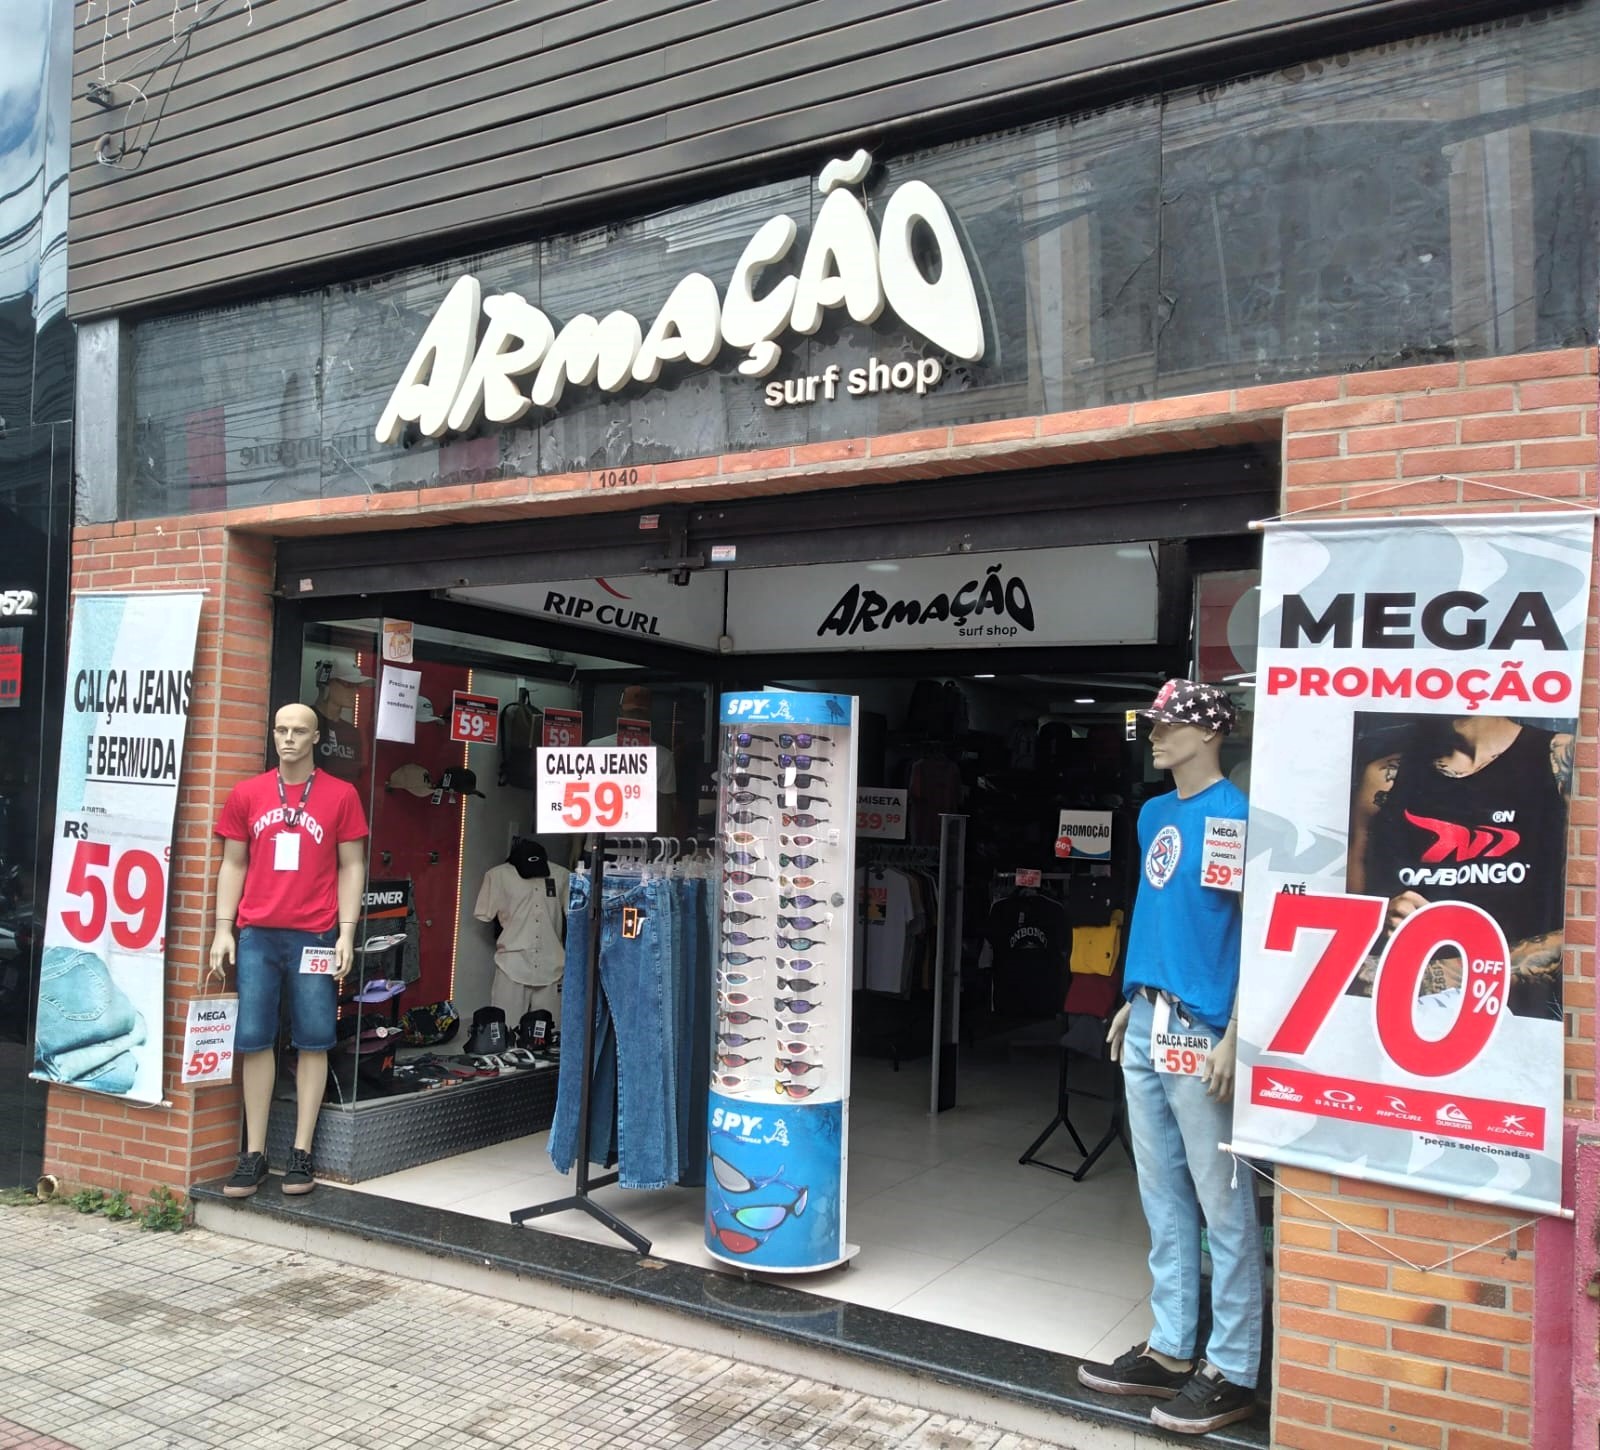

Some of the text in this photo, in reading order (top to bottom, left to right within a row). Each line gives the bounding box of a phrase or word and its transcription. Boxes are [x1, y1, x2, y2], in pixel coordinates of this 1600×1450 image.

[375, 148, 985, 444] ARMAÇÃO
[765, 356, 943, 408] surf shop
[599, 469, 639, 488] 1040
[0, 590, 36, 616] 52
[817, 563, 1036, 637] ARMAÇÃO
[544, 591, 662, 637] RIP CURL
[1279, 590, 1569, 651] MEGA
[958, 623, 1019, 638] surf shop
[1267, 660, 1573, 711] PROMOÇÃO
[74, 669, 129, 725] CALÇA
[133, 669, 193, 716] JEANS
[727, 699, 770, 715] SPY
[459, 711, 484, 737] 59
[549, 727, 570, 747] 59
[97, 736, 177, 780] BERMUDA
[546, 753, 648, 780] CALÇA JEANS
[624, 785, 641, 799] 99
[856, 795, 901, 807] MISETA
[253, 807, 324, 844] ONBONGO
[1060, 823, 1110, 838] PROMOÇÃO
[1212, 827, 1238, 838] MEGA
[1206, 839, 1242, 850] PROMOÇÃO
[1211, 852, 1237, 860] CAMISETA
[1399, 862, 1527, 886] ONBONGO
[360, 891, 404, 906] KENNER
[1281, 883, 1307, 896] ATÉ
[310, 958, 328, 972] 59
[1472, 959, 1503, 975] OFF
[1262, 892, 1509, 1077] 70
[1473, 980, 1499, 1015] %
[198, 1011, 227, 1022] MEGA
[190, 1023, 231, 1035] PROMOÇÃO
[195, 1038, 225, 1046] CAMISETA
[1156, 1034, 1209, 1050] CALÇA JEANS
[1314, 1098, 1364, 1113] OAKLEY
[712, 1107, 763, 1136] SPY
[1487, 1125, 1535, 1138] KENNER
[1458, 1142, 1531, 1160] selecionadas
